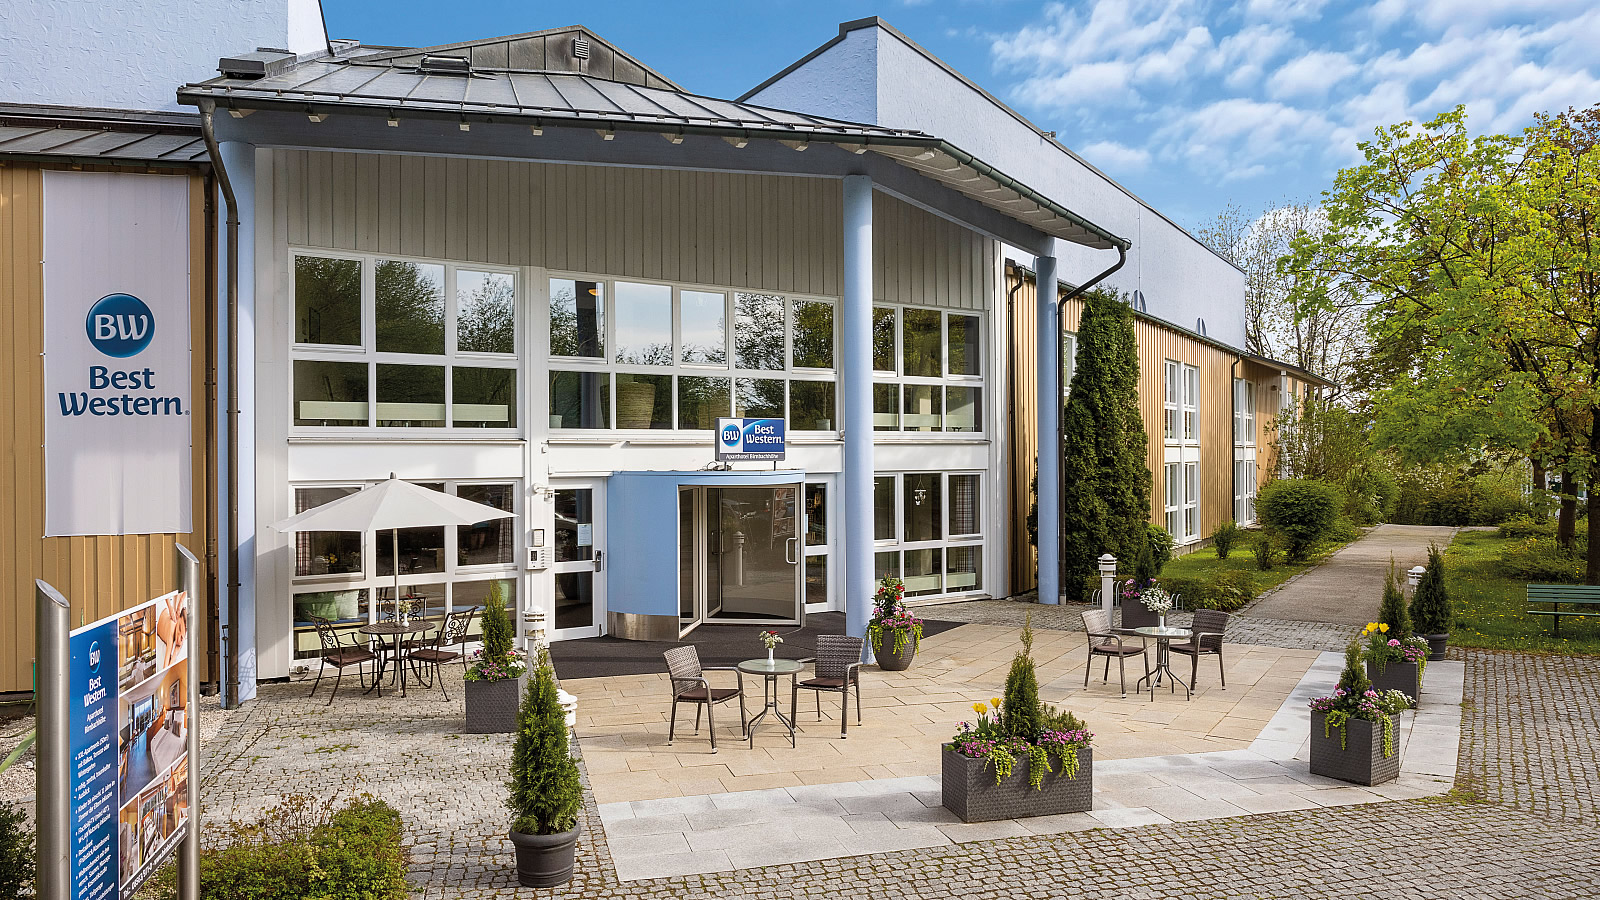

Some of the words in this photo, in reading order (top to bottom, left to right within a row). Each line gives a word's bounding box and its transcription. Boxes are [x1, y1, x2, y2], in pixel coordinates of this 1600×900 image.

[95, 314, 148, 341] BW
[89, 365, 156, 390] Best
[58, 392, 183, 416] Western
[723, 430, 740, 441] BW
[754, 424, 775, 434] Best
[746, 434, 782, 444] Western
[90, 649, 101, 667] BW
[89, 675, 102, 692] Best
[83, 687, 107, 708] Western
